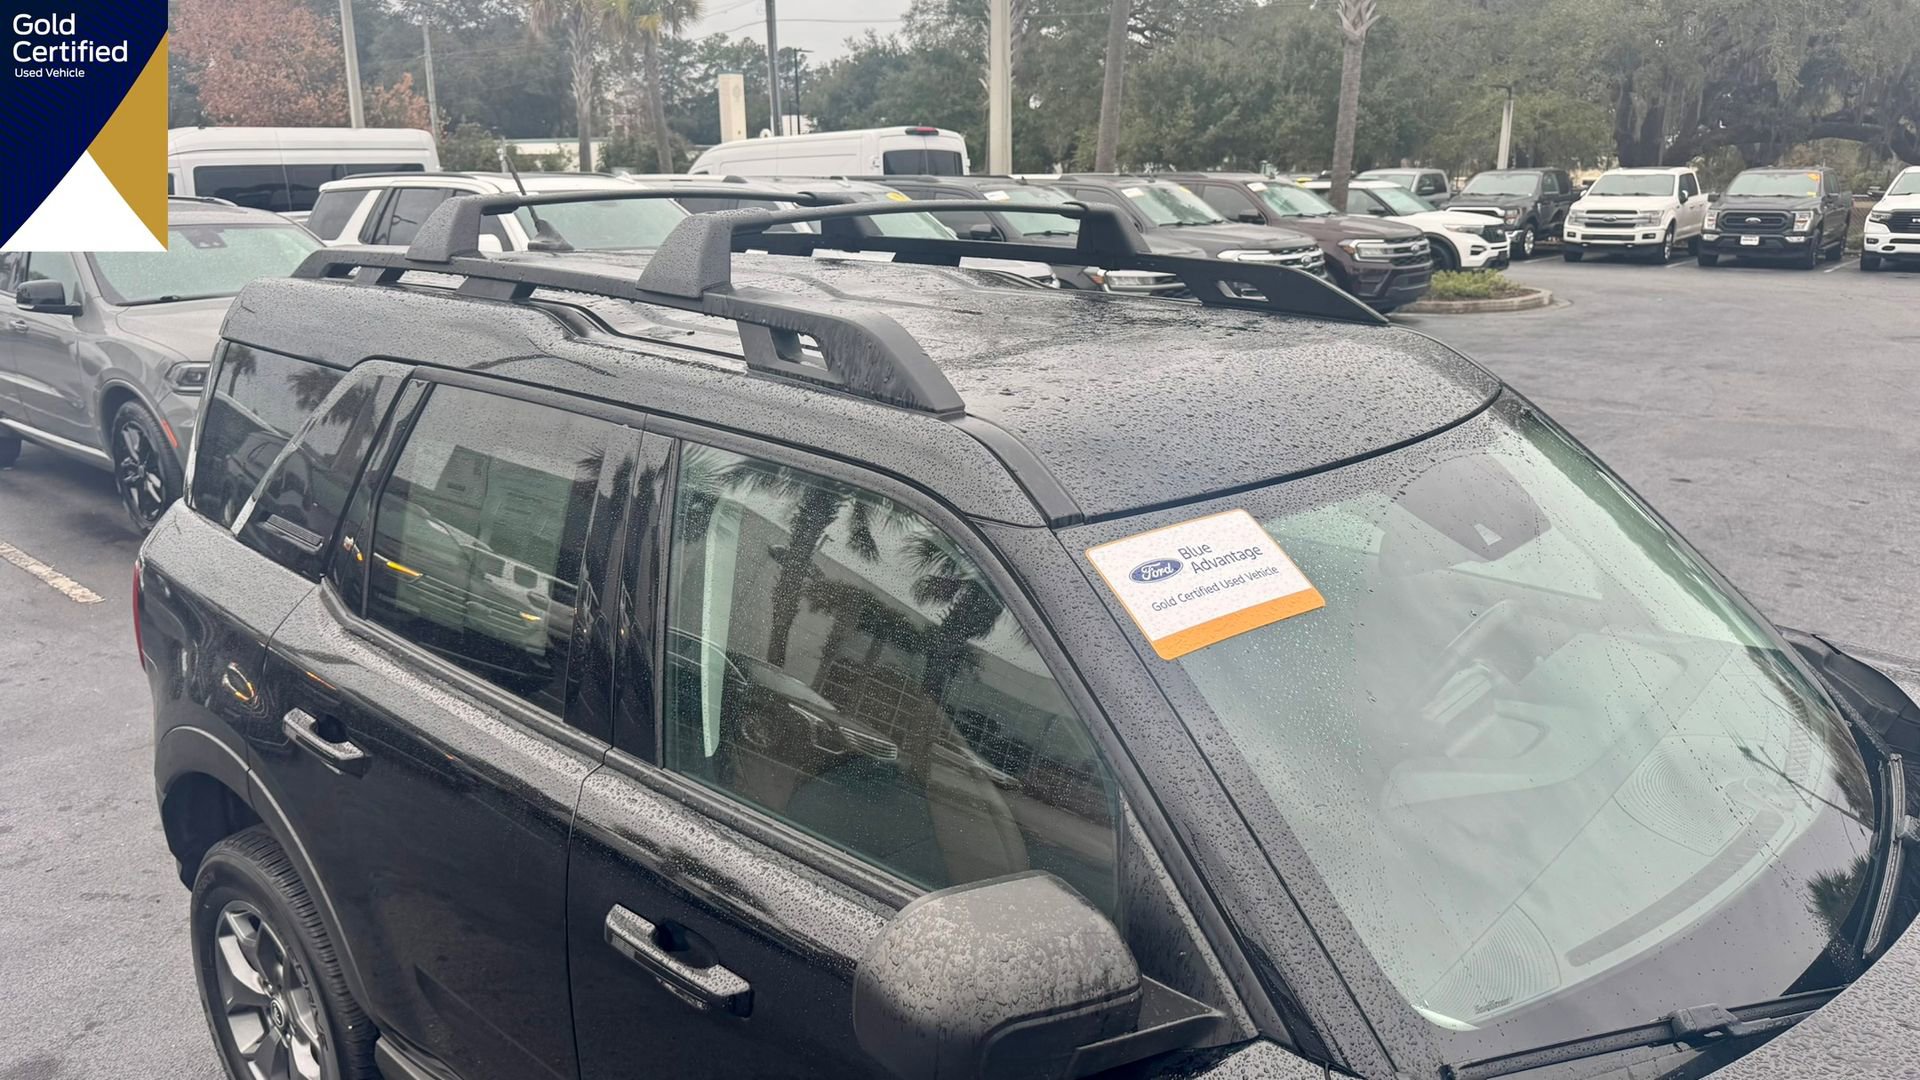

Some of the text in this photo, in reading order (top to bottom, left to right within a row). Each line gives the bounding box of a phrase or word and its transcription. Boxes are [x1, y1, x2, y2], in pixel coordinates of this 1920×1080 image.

[1178, 542, 1212, 561] Blue
[1190, 545, 1264, 574] Advantage
[1140, 560, 1175, 581] Ford
[1151, 565, 1280, 612] Gold Certified Used Vehicle
